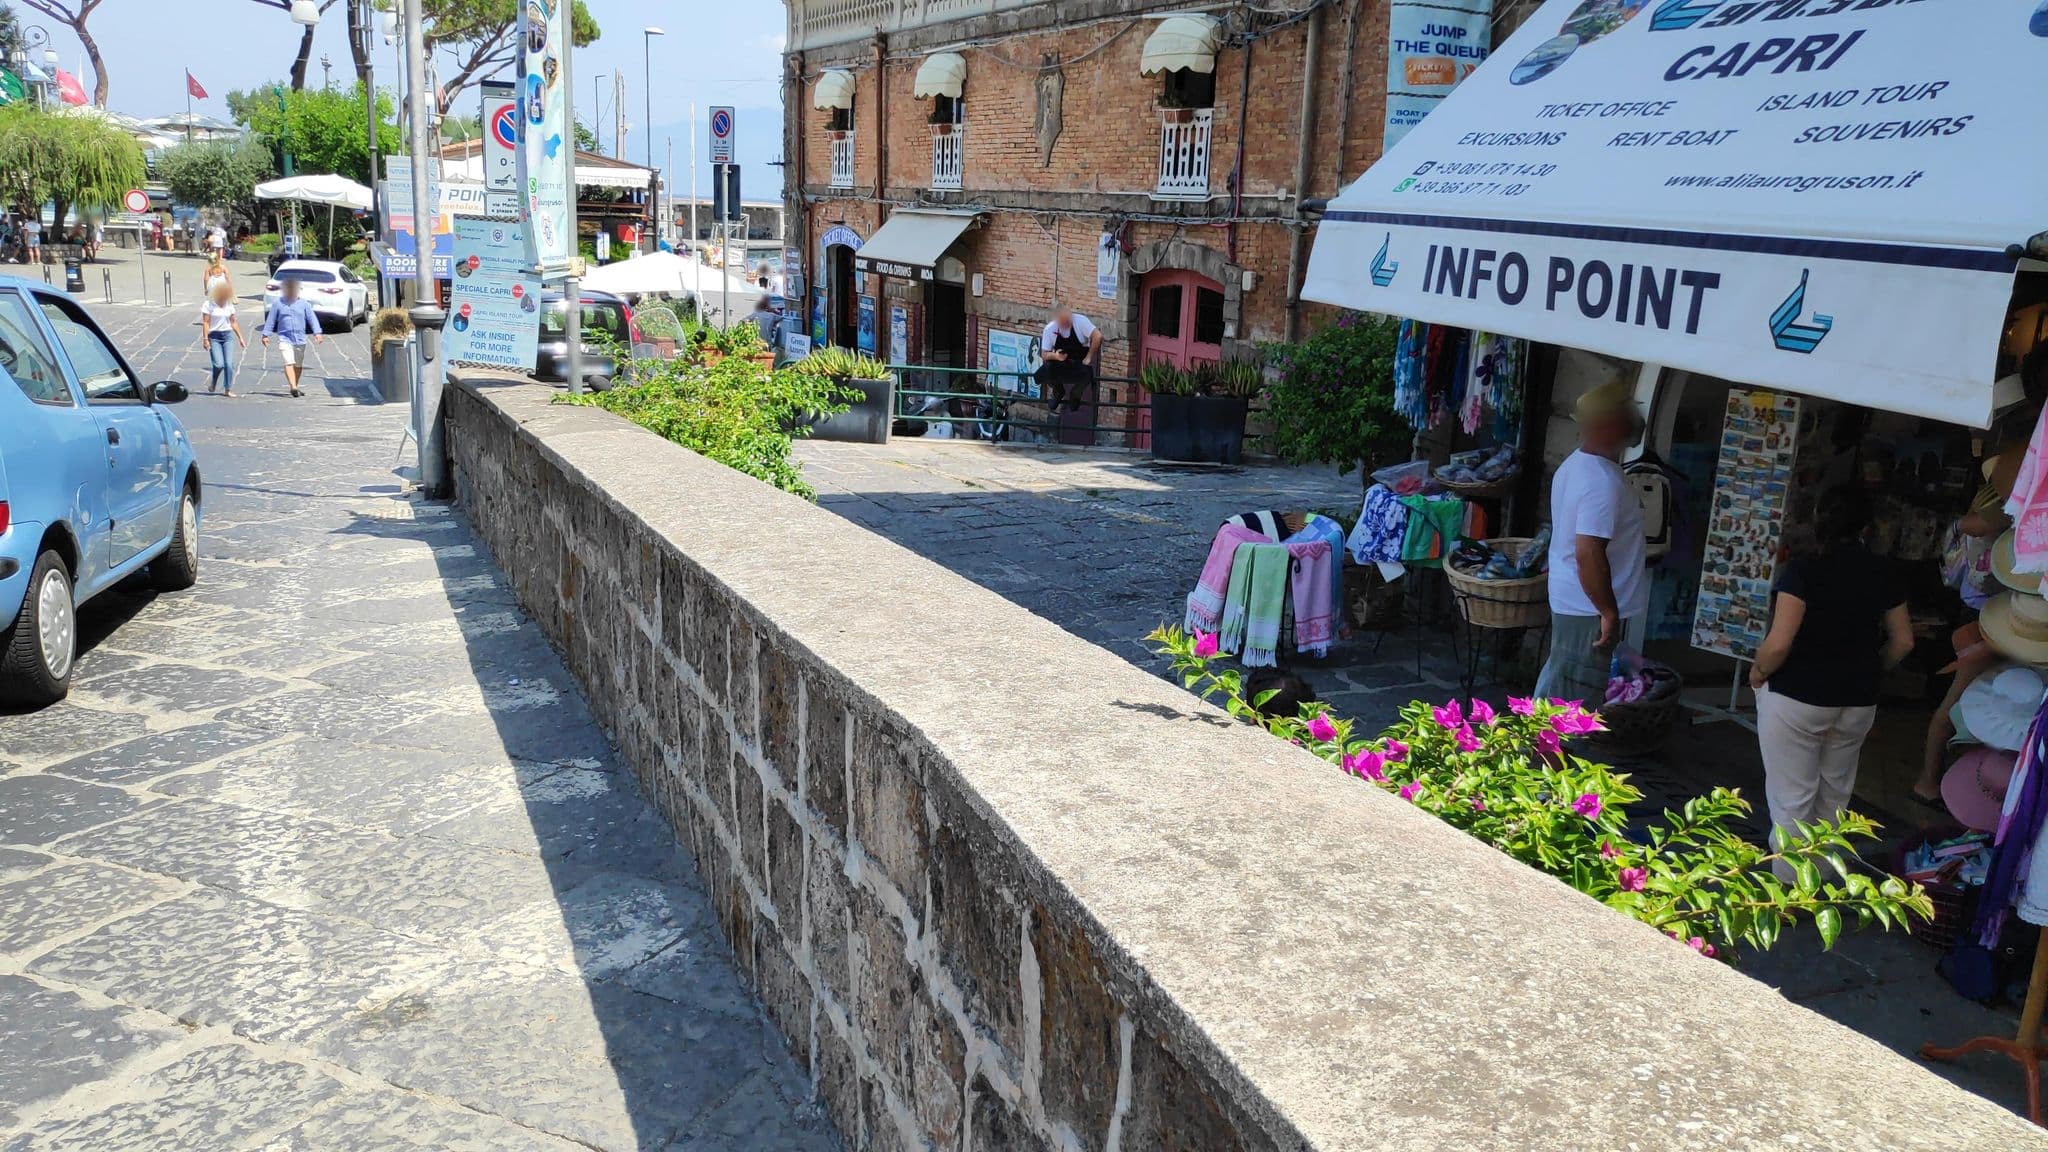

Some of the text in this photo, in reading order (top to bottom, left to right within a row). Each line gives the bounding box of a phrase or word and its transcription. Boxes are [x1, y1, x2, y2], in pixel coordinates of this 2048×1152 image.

[1421, 23, 1467, 39] JUMP
[1394, 39, 1488, 61] THE QUEUE
[1663, 29, 1867, 82] CAPRI
[1756, 81, 1950, 113] ISLAND TOUR
[1535, 100, 1677, 119] TICKET OFFICE
[1793, 115, 1974, 145] SOUVENIRS
[1457, 131, 1567, 146] EXCURSIONS
[1606, 130, 1739, 147] RENT BOAT
[1436, 162, 1462, 175] +39
[1412, 181, 1437, 193] +39
[1664, 170, 1928, 193] www.alilaurogruson.it
[386, 258, 416, 266] BOOK
[876, 261, 889, 274] FOOD
[893, 264, 912, 278] DRINKS
[456, 283, 488, 294] SPECIALE
[490, 286, 511, 296] CAPRI
[1422, 244, 1721, 335] INFO POINT
[471, 330, 516, 342] ASK INSIDE
[470, 341, 513, 353] FOR MORE
[463, 351, 521, 366] INFORMATION!
